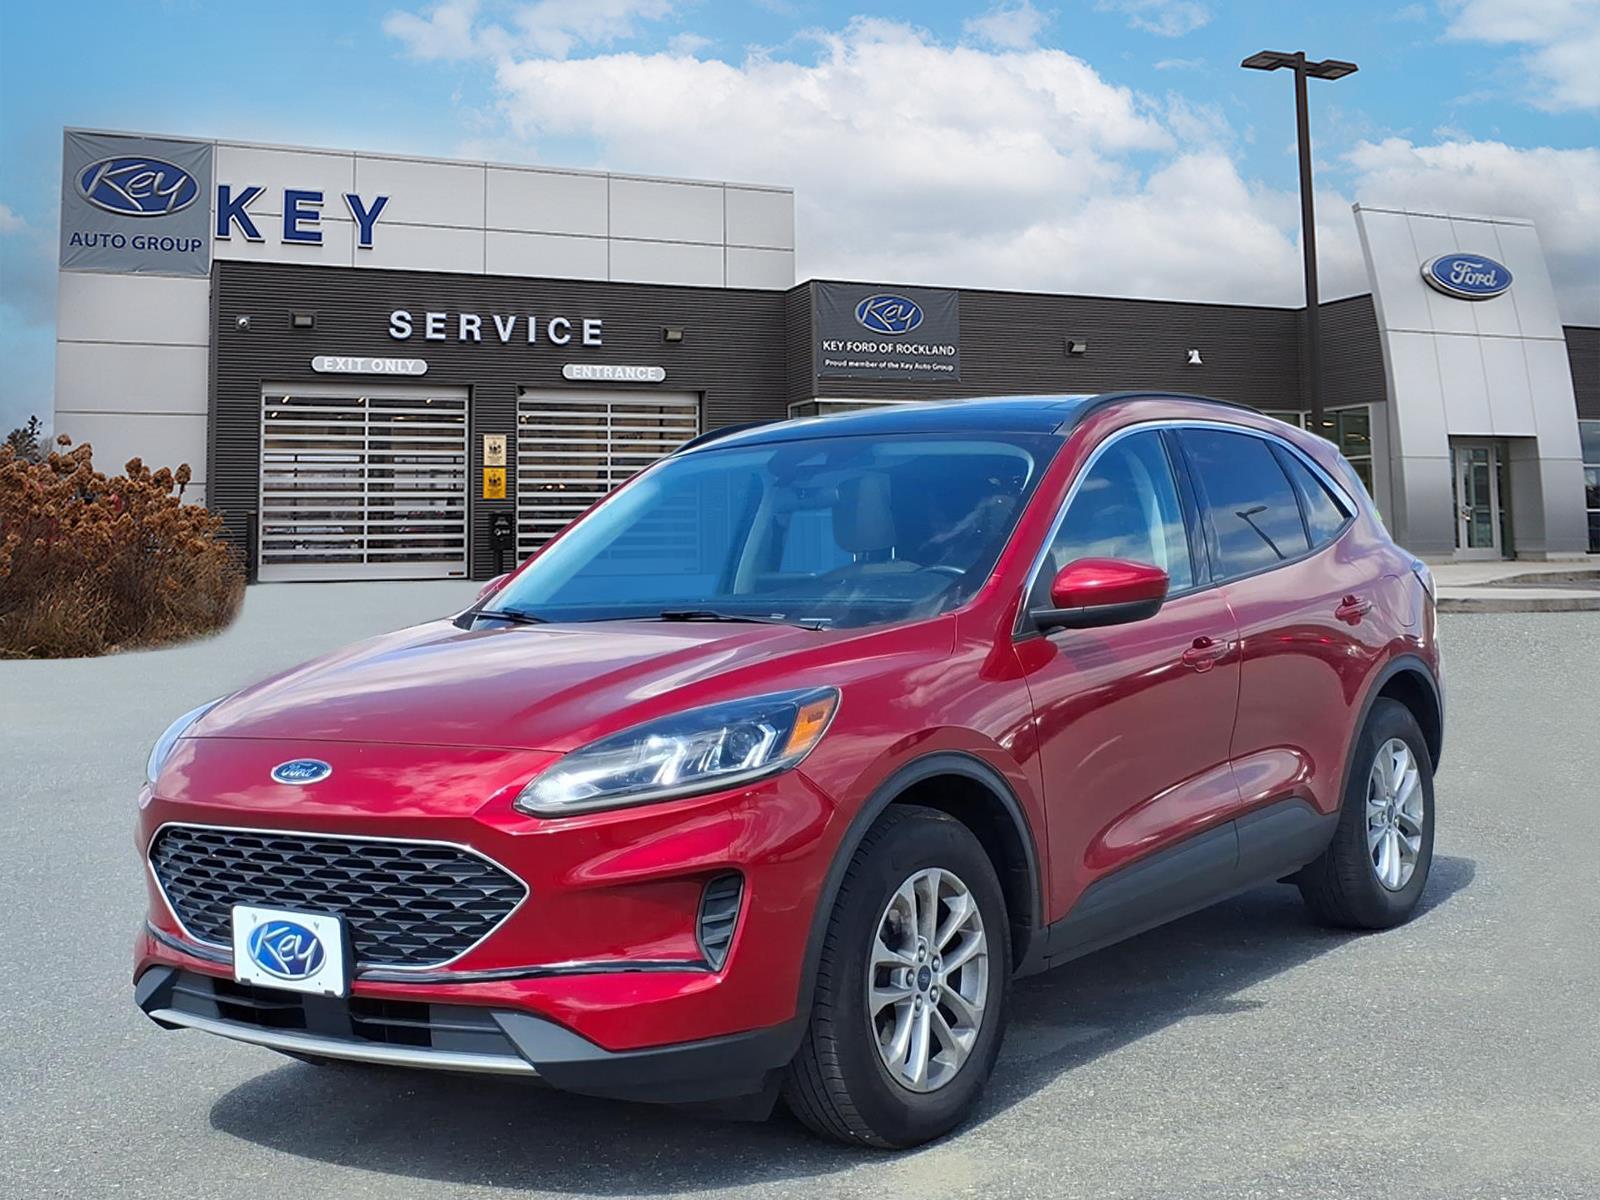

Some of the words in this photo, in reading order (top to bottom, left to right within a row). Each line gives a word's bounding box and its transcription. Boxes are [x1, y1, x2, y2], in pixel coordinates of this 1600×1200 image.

[86, 161, 188, 212] Key
[214, 183, 391, 249] KEY
[69, 231, 127, 249] AUTO
[131, 234, 203, 253] GROUP
[1450, 260, 1498, 287] Ford
[861, 299, 917, 332] Key
[388, 310, 604, 346] SERVICE
[822, 340, 845, 352] KEY
[846, 341, 878, 353] FORD
[879, 342, 894, 354] OF
[896, 343, 956, 356] ROCKLAND
[323, 358, 365, 372] EXIT
[371, 359, 416, 374] ONLY
[571, 366, 657, 380] ENTRANCE
[824, 359, 848, 368] Proud
[848, 360, 878, 369] member
[879, 360, 887, 369] of
[887, 361, 899, 369] the
[900, 362, 913, 371] Key
[914, 362, 931, 371] Auto
[932, 363, 954, 373] Group
[281, 762, 318, 777] Ford
[254, 923, 318, 975] Key
